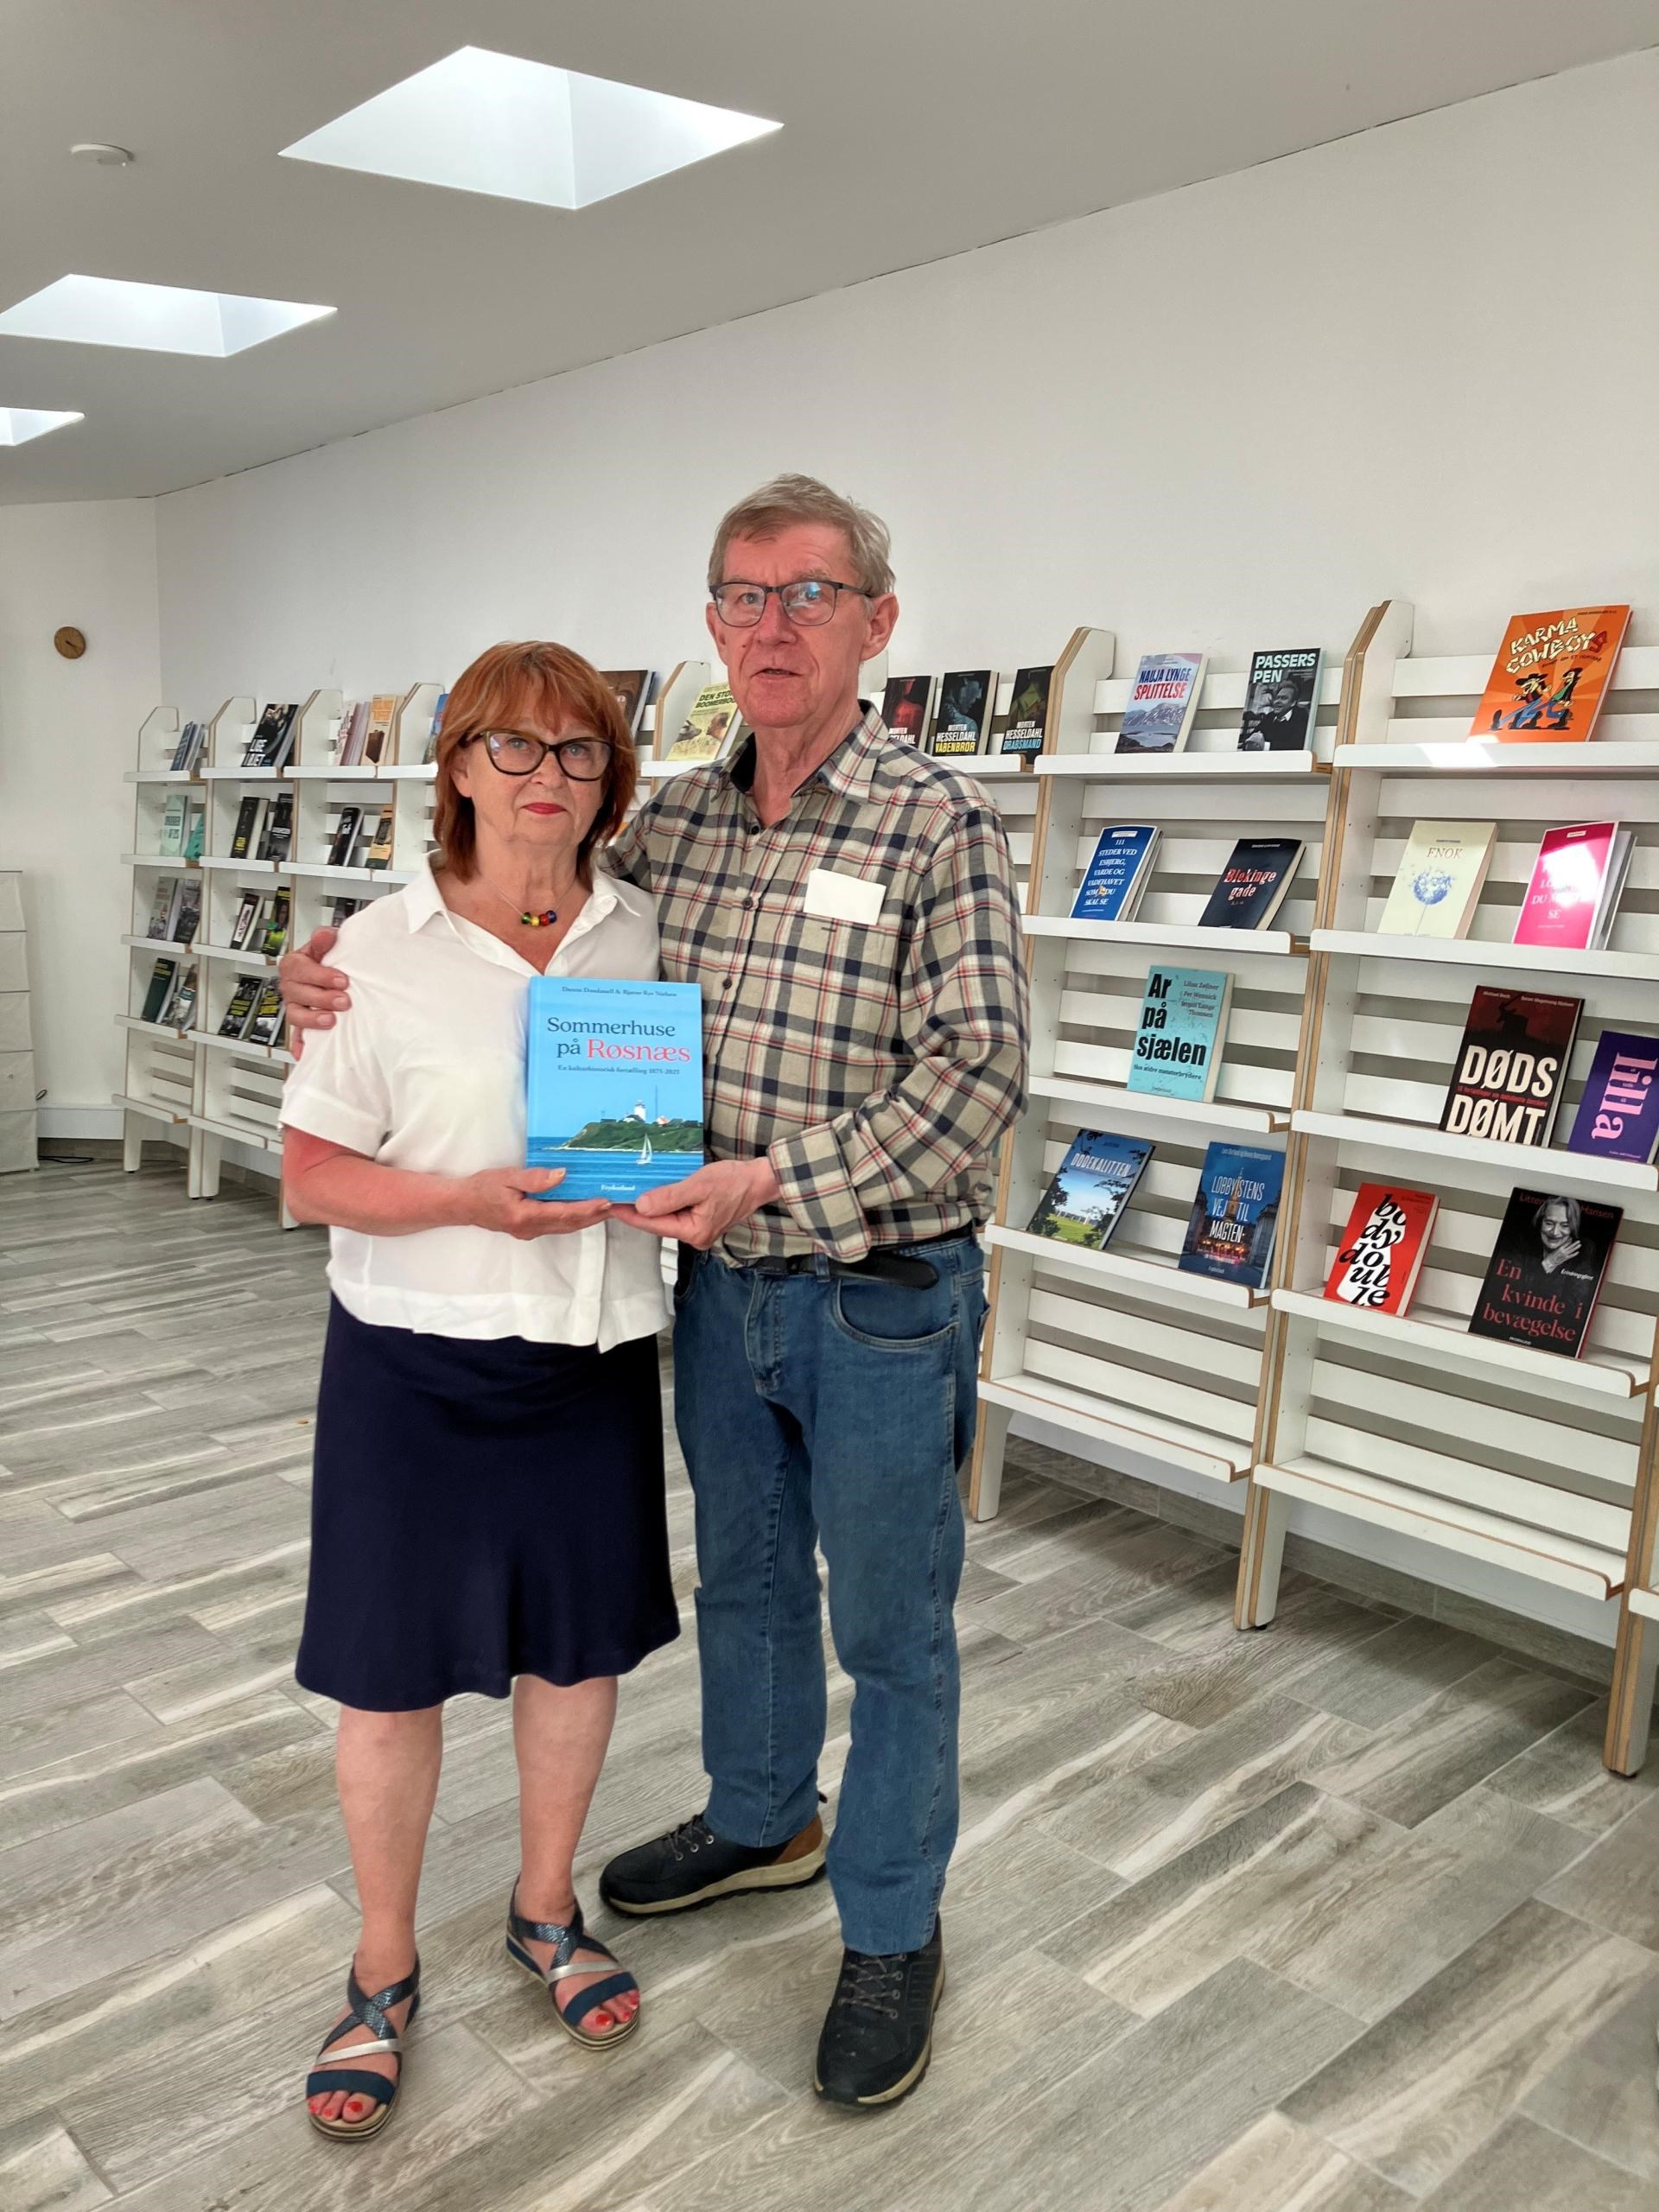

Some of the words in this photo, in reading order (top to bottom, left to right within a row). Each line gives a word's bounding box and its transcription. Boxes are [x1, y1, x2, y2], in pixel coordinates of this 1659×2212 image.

[1510, 617, 1579, 655] KARMA
[1255, 652, 1317, 669] PASSERS
[1139, 669, 1165, 683] NAUJA
[1165, 668, 1192, 682] LYNGE
[1253, 669, 1283, 683] PEN
[1134, 683, 1187, 701] SPLITTELSE
[936, 731, 976, 742] HESSELDAHL
[1005, 728, 1043, 740] HESSELDAHL
[1224, 868, 1277, 885] Blekinge
[1228, 883, 1256, 900] gade
[1548, 910, 1562, 919] SE
[1147, 973, 1173, 999] Ar
[1141, 1001, 1167, 1029] på
[547, 1017, 676, 1037] Sommerhuse
[556, 1039, 581, 1058] på
[587, 1039, 691, 1062] Røsnæs
[1136, 1033, 1207, 1066] sjælen
[1459, 1045, 1558, 1097] DØDS
[1446, 1094, 1547, 1146] DØMT
[1211, 1175, 1265, 1201] LOBBYISTENS
[1211, 1198, 1228, 1217] VEJ
[1236, 1202, 1249, 1222] TIL
[1360, 1218, 1402, 1249] dy
[1338, 1243, 1384, 1268] do
[1496, 1258, 1522, 1280] En
[1502, 1283, 1566, 1314] kvinde
[1575, 1302, 1584, 1319] i
[1482, 1302, 1577, 1342] bevægelse
